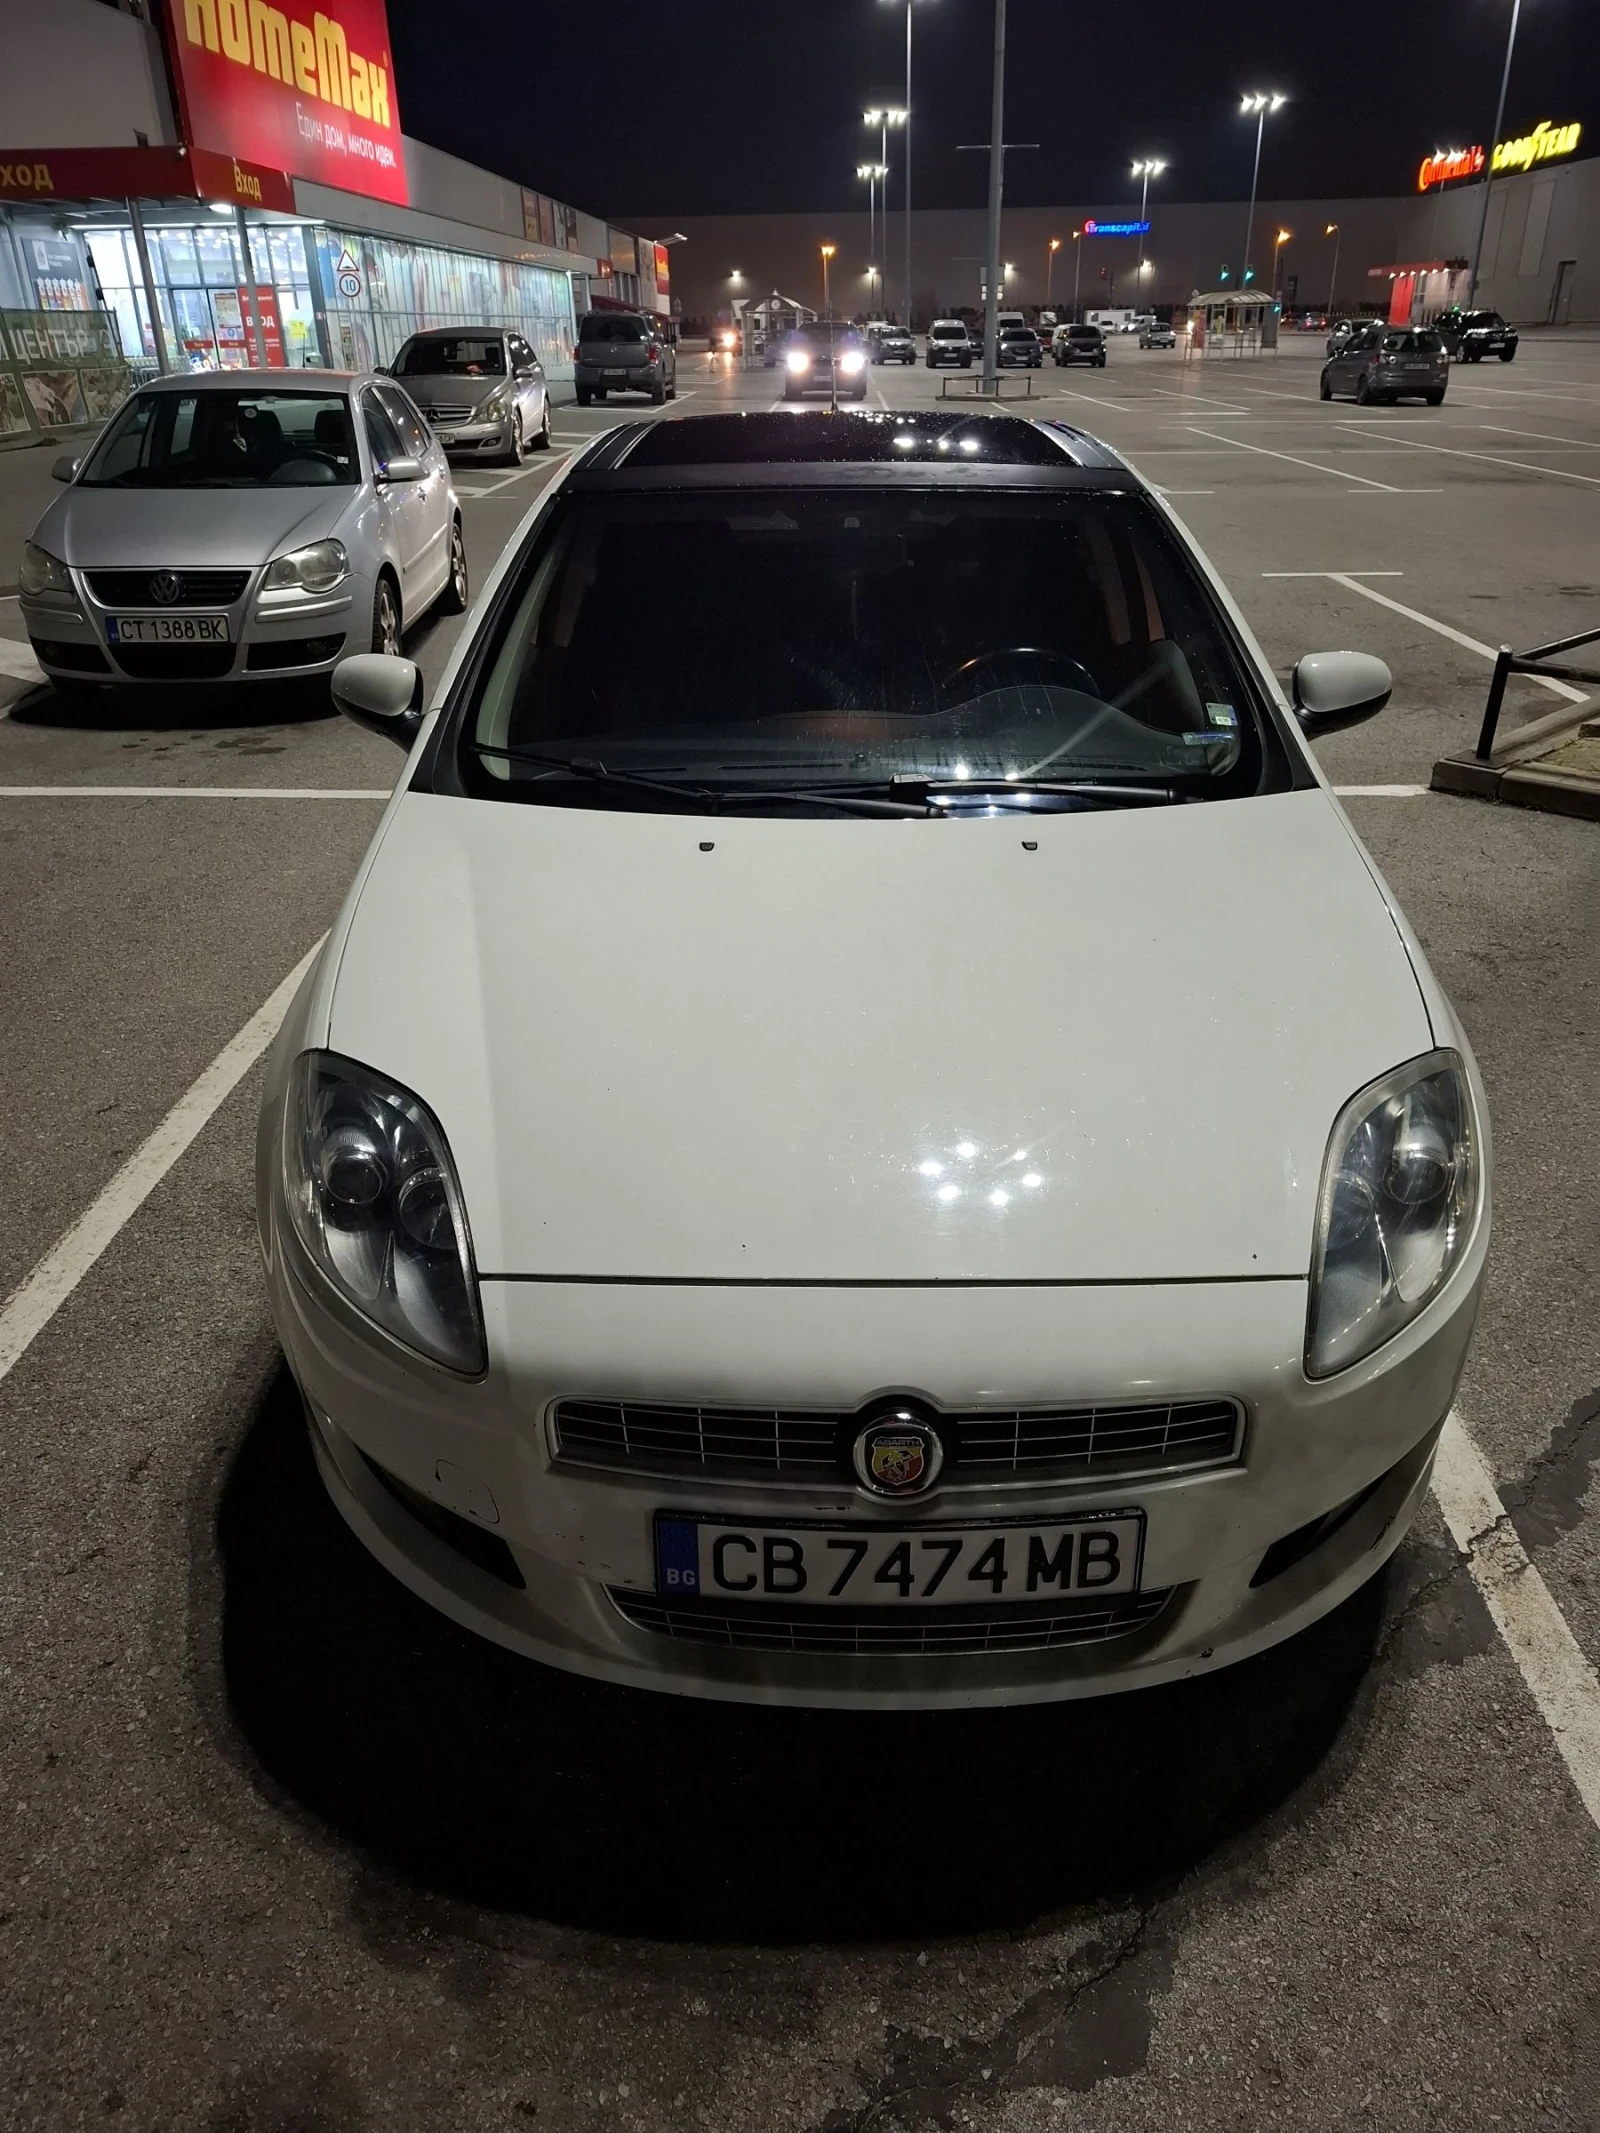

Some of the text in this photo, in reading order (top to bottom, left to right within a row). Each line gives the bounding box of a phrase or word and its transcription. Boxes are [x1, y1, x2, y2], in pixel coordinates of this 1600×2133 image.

[295, 101, 323, 143] Един
[324, 124, 348, 156] дом,
[348, 133, 374, 160] много
[1492, 120, 1581, 172] GOODYEAR
[233, 165, 262, 201] Вход
[344, 279, 356, 292] 10
[246, 316, 275, 327] ВОД
[8, 328, 88, 366] ЦЕНТЪР
[151, 620, 195, 640] 1388
[666, 1531, 1121, 1598] BG CB 7474 MB
